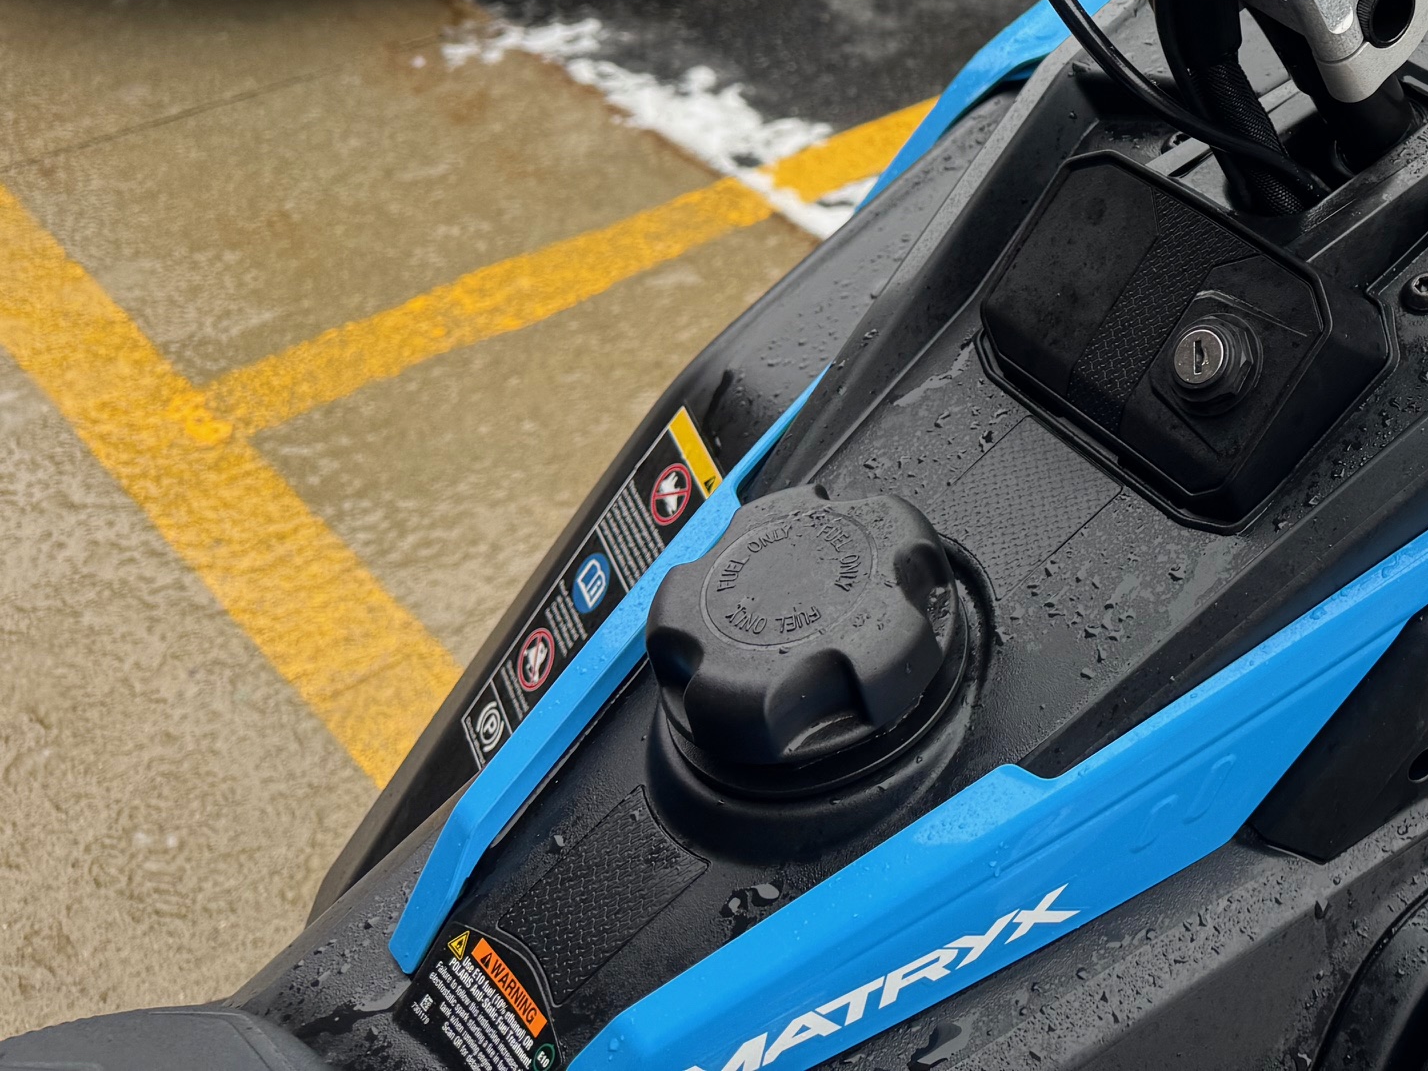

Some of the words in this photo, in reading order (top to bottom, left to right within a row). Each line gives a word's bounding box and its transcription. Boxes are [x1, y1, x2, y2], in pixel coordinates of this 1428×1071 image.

[816, 525, 853, 553] FUEL
[716, 555, 750, 592] FUEL
[747, 525, 793, 553] ONLY
[834, 554, 862, 592] ONLY
[725, 604, 767, 635] ONLY
[775, 606, 822, 633] FUEL
[429, 971, 456, 1007] electrostatic
[455, 1004, 469, 1022] spark
[482, 1040, 489, 1048] a
[436, 961, 451, 983] Failure
[450, 979, 457, 989] to
[455, 985, 470, 1006] follow
[469, 1002, 480, 1017] this
[477, 1012, 500, 1045] instruction
[449, 957, 474, 988] POLARIS
[471, 985, 498, 1021] Anti-Static
[495, 1016, 510, 1036] Fuel
[462, 956, 474, 973] Use
[472, 968, 485, 985] E10
[482, 981, 496, 998] fuel
[492, 993, 507, 1014] (10%
[504, 1011, 526, 1041] ethanol)
[522, 1035, 534, 1050] OR
[490, 960, 538, 1025] WARNING
[439, 1001, 452, 1018] tank
[451, 1015, 464, 1033] when
[442, 1021, 455, 1040] Scan
[536, 1050, 550, 1069] E10
